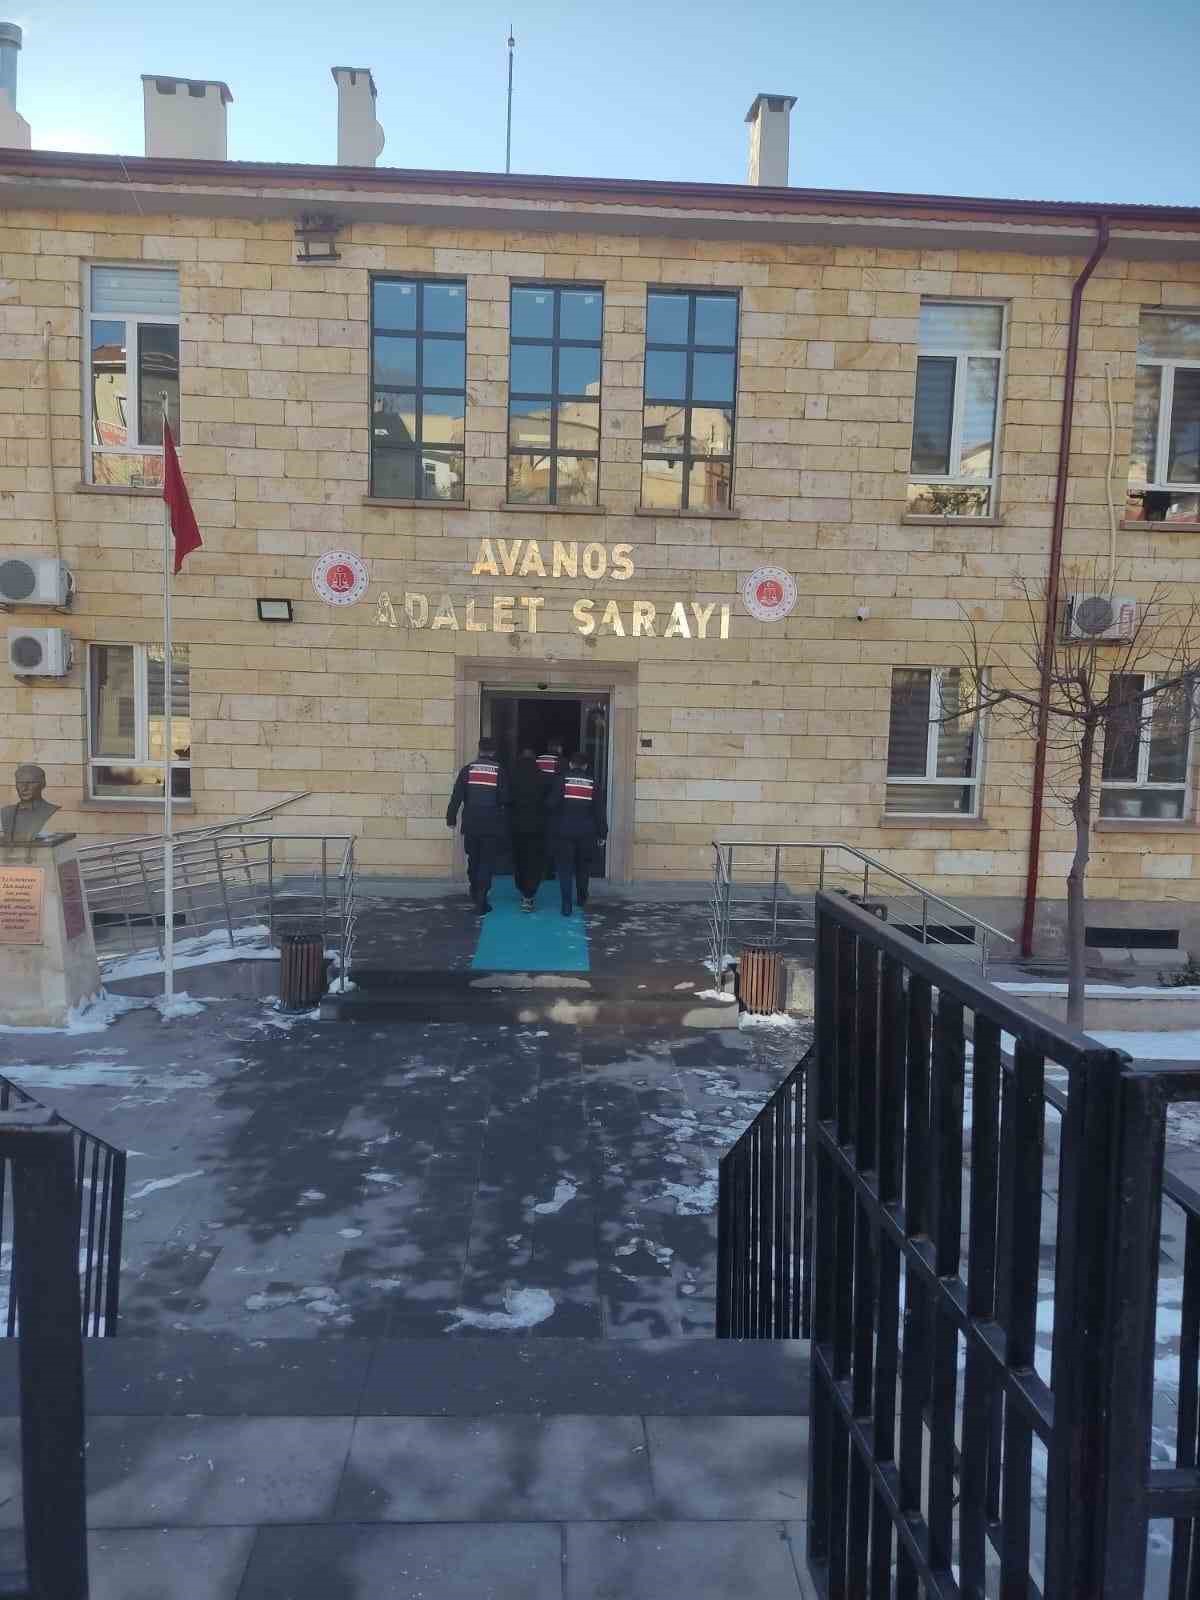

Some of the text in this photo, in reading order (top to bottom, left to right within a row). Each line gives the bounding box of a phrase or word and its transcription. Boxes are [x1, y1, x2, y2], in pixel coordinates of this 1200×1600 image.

[472, 538, 635, 580] AVANOS
[375, 591, 731, 640] ADALET SARAYI
